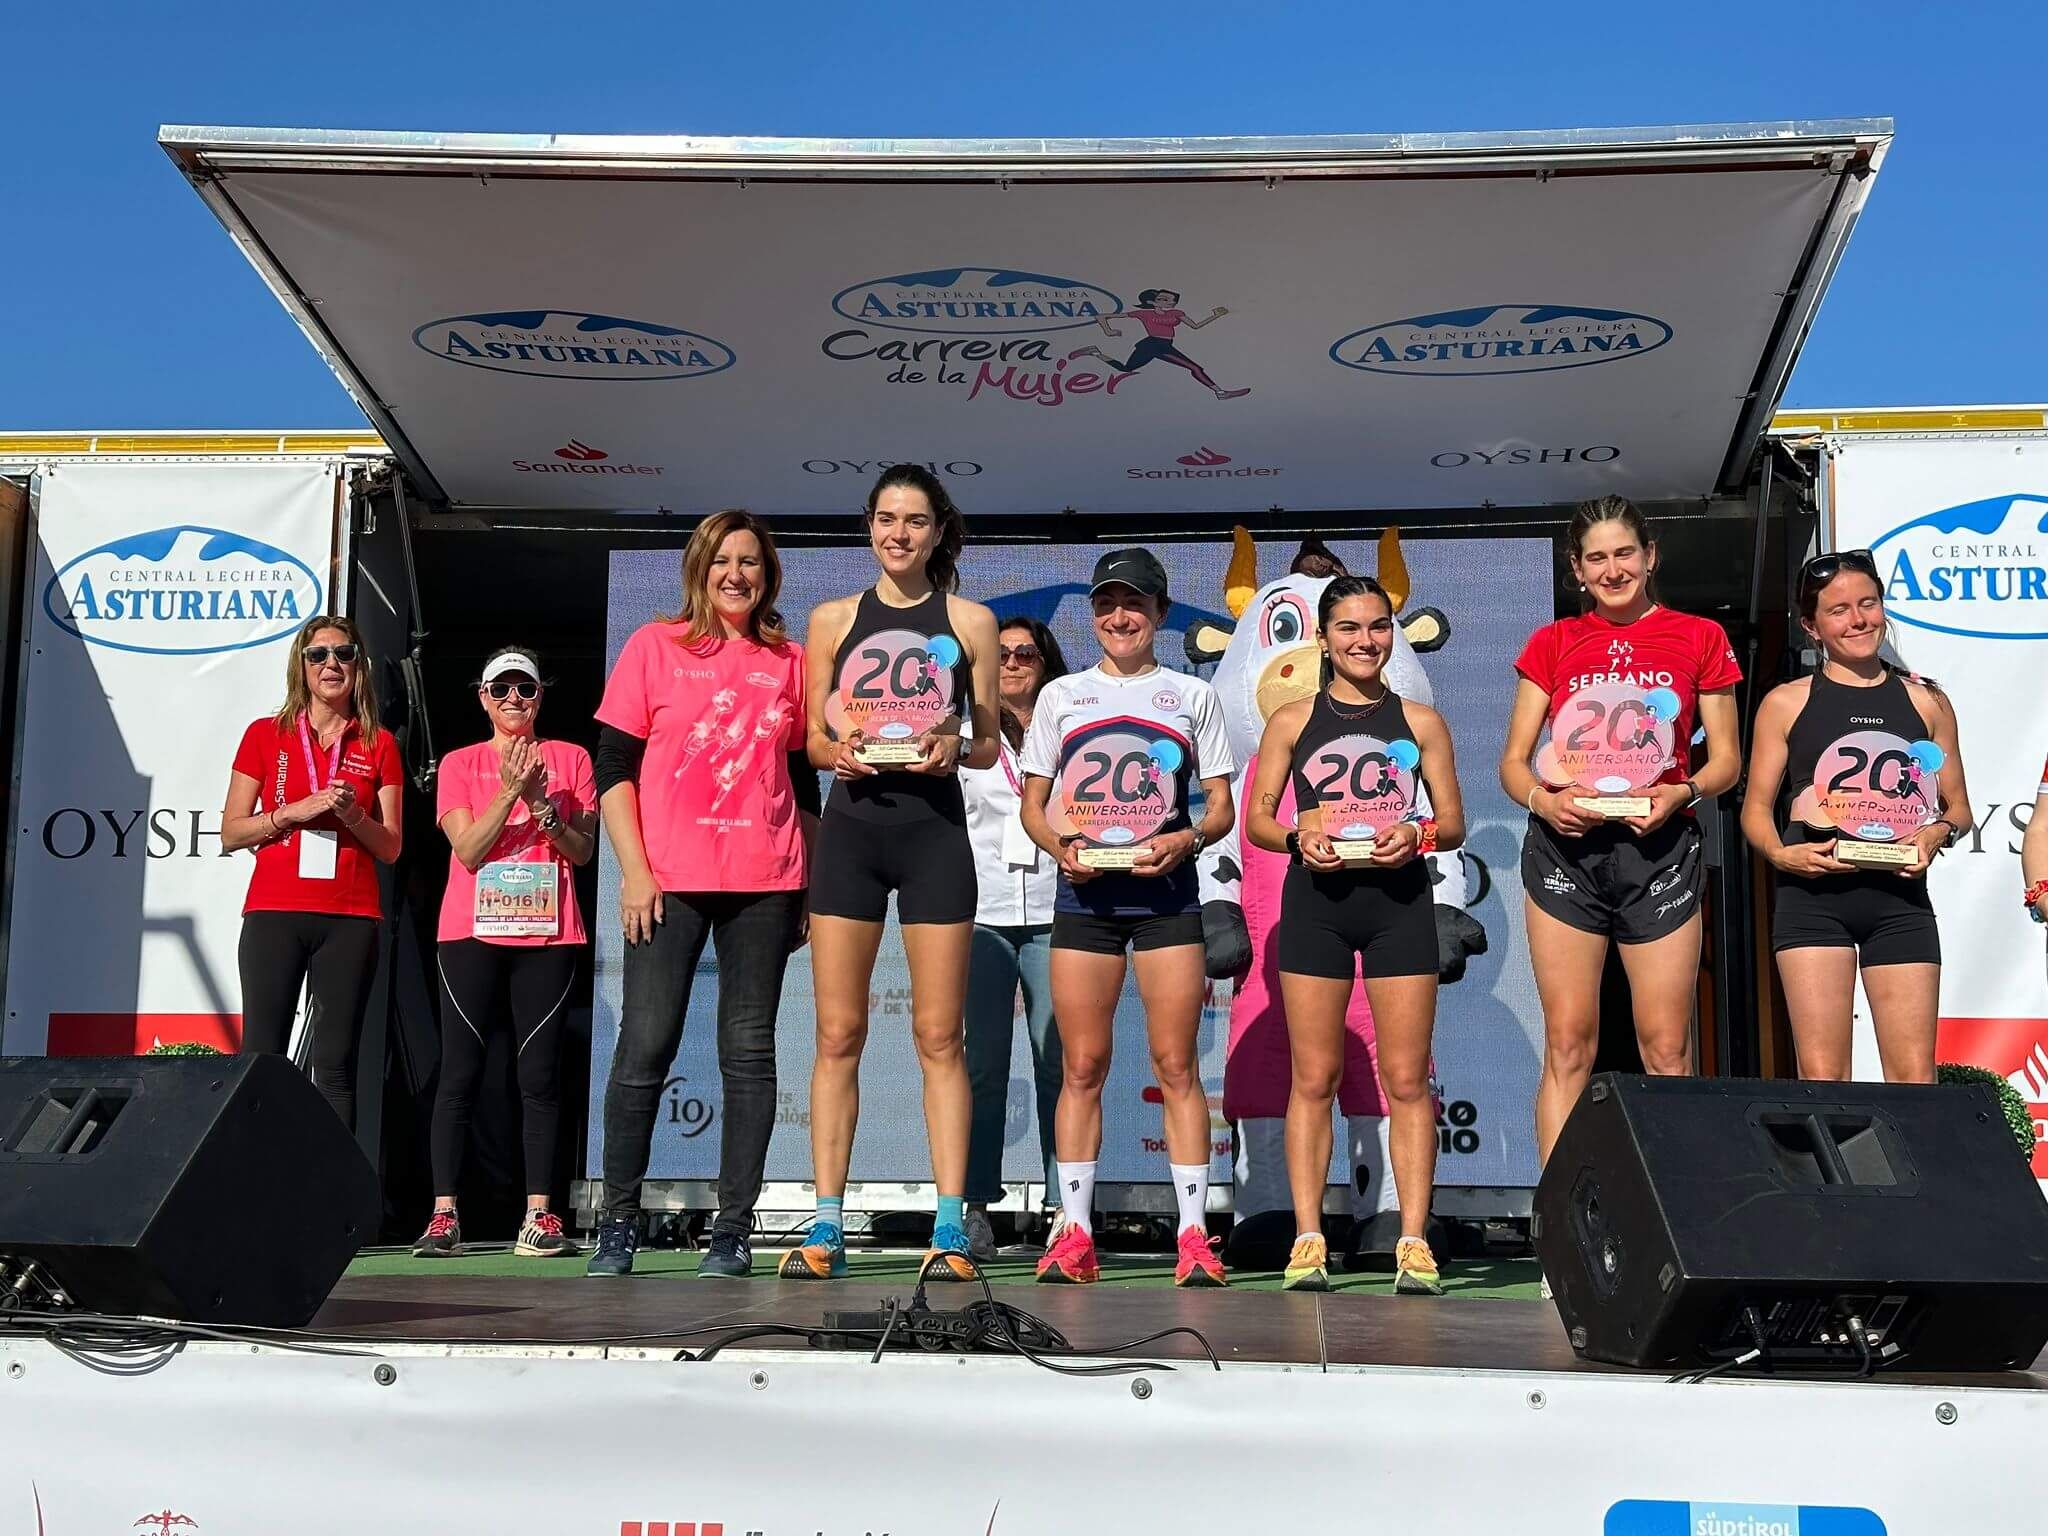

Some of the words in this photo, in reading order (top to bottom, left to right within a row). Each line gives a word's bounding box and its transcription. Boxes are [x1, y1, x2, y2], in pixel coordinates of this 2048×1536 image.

[858, 292, 1102, 318] ASTURIANA
[895, 289, 990, 300] CENTRAL
[997, 289, 1089, 300] LECHERA
[480, 328, 583, 344] CENTRAL
[592, 335, 695, 348] LECHERA
[1409, 328, 1516, 342] CENTRAL
[1528, 321, 1637, 337] LECHERA
[445, 329, 715, 367] ASTURIANA
[821, 330, 1052, 363] Carrera
[1356, 333, 1645, 363] ASTURIANA
[887, 363, 928, 385] de
[937, 363, 967, 385] la
[966, 359, 1142, 406] Mujer
[513, 458, 664, 475] Santander
[802, 459, 984, 476] OYSO
[1430, 445, 1621, 469] OYSHO
[1126, 466, 1283, 480] Santander
[1932, 545, 2036, 558] CENTRAL
[110, 570, 196, 583] CENTRAL
[206, 569, 293, 583] LECHERA
[63, 573, 301, 621] ASTURIANA
[852, 647, 929, 699] 20
[1568, 671, 1674, 692] SERRANO
[843, 700, 943, 712] ANIVERSARIO
[1567, 699, 1646, 752] 20
[1850, 716, 1884, 725] OYSHO
[1558, 753, 1661, 765] ANIVERSARIO
[1073, 751, 1153, 803] 20
[1314, 751, 1389, 801] 20
[1828, 746, 1911, 799] 20
[1065, 805, 1165, 816] ANIVERSARIO
[42, 808, 260, 859] OYSH
